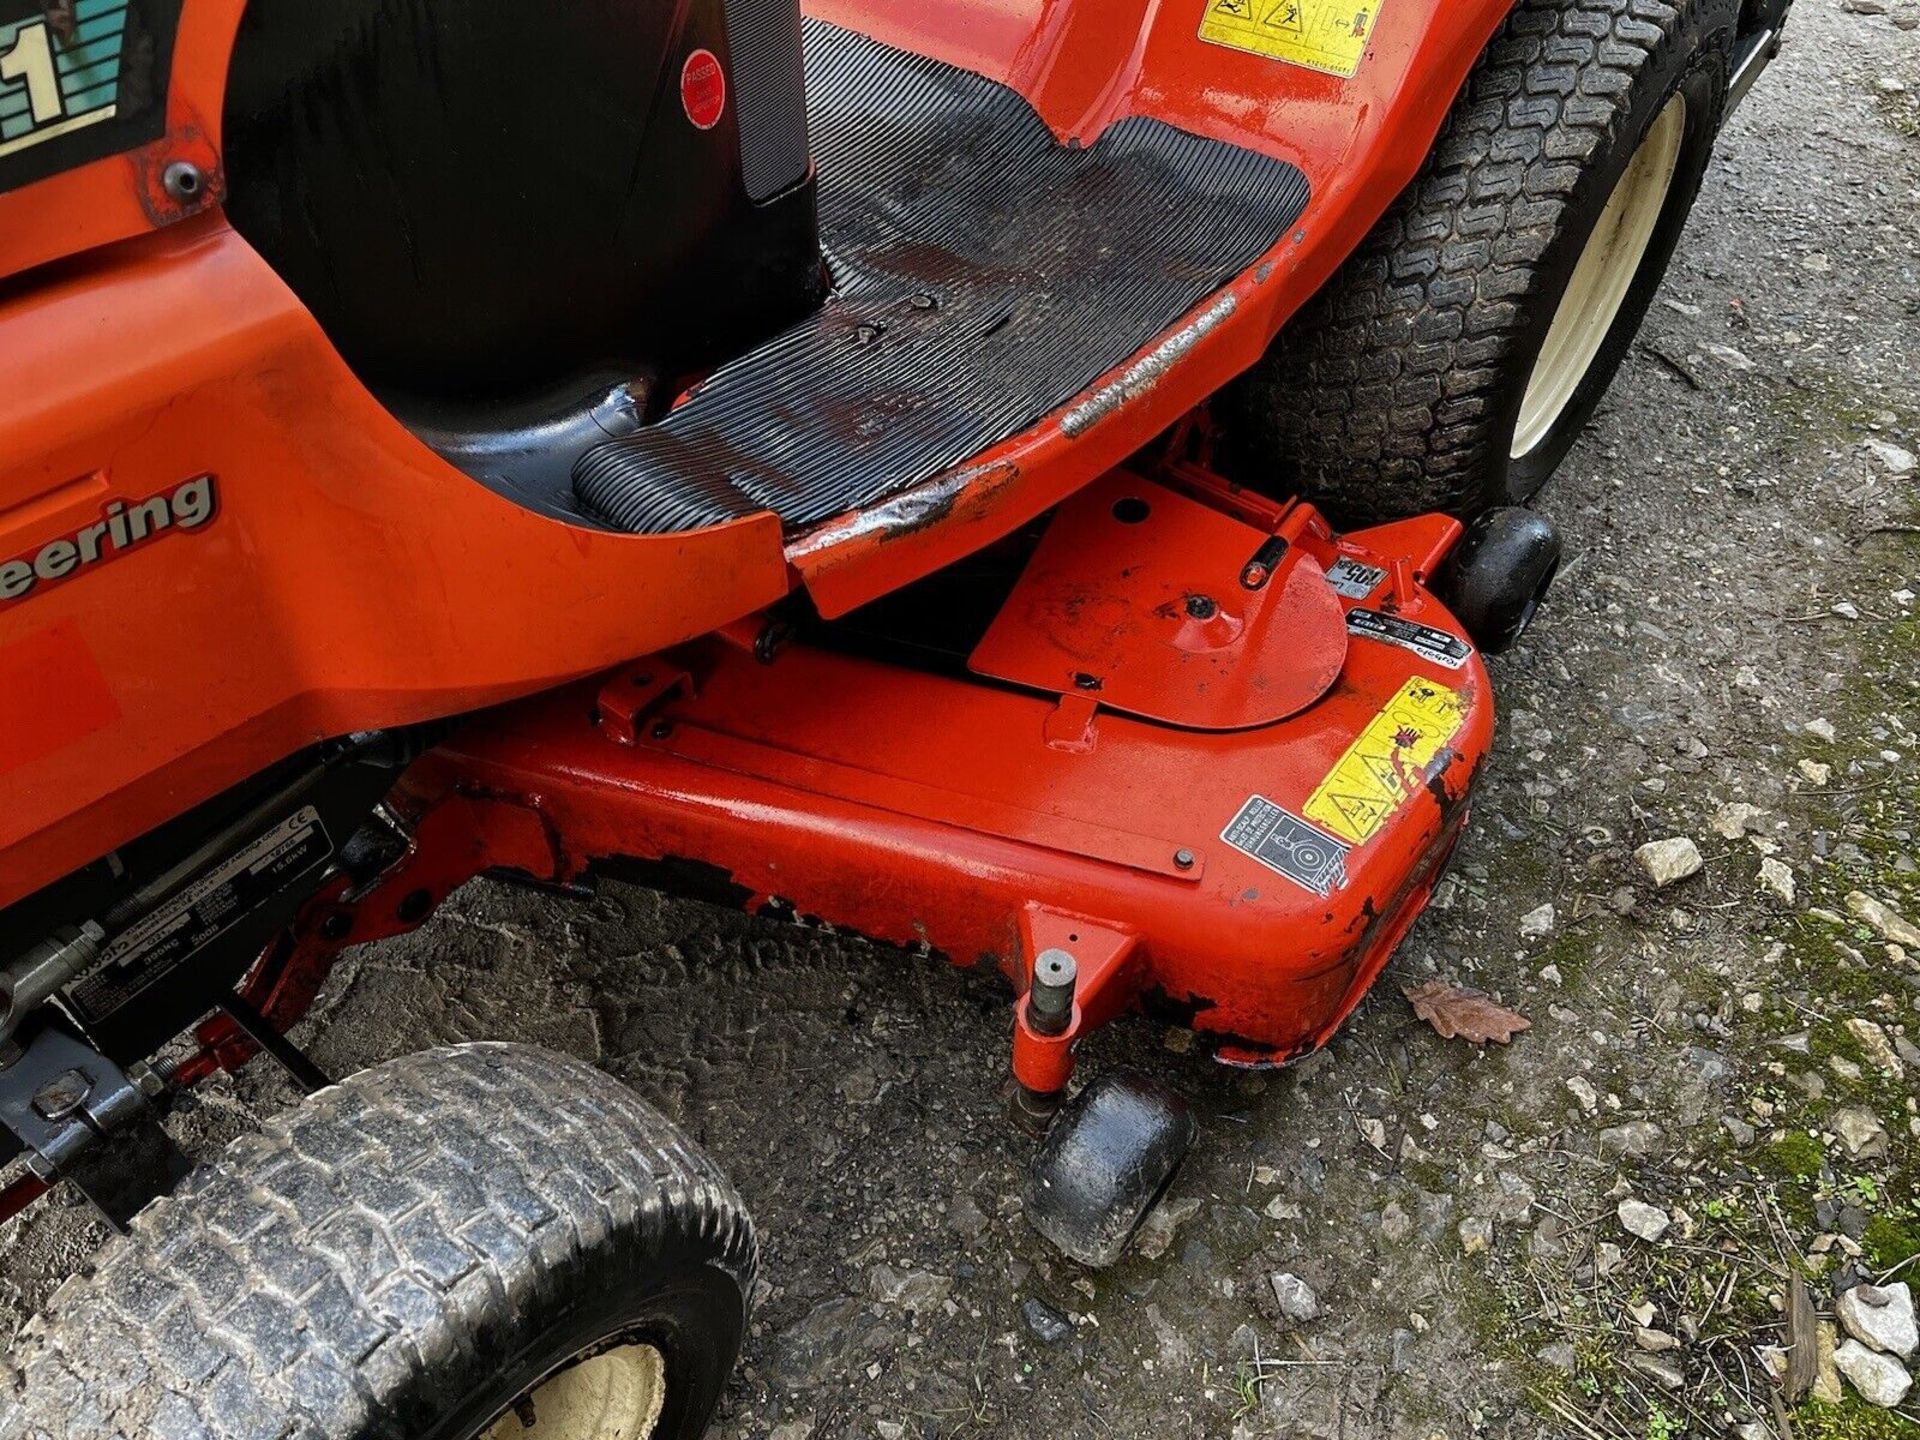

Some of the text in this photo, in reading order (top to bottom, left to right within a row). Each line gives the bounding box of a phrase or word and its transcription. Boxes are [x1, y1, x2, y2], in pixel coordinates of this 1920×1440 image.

[1, 23, 61, 123] 1
[0, 474, 211, 601] eering
[1417, 646, 1459, 668] Kubota
